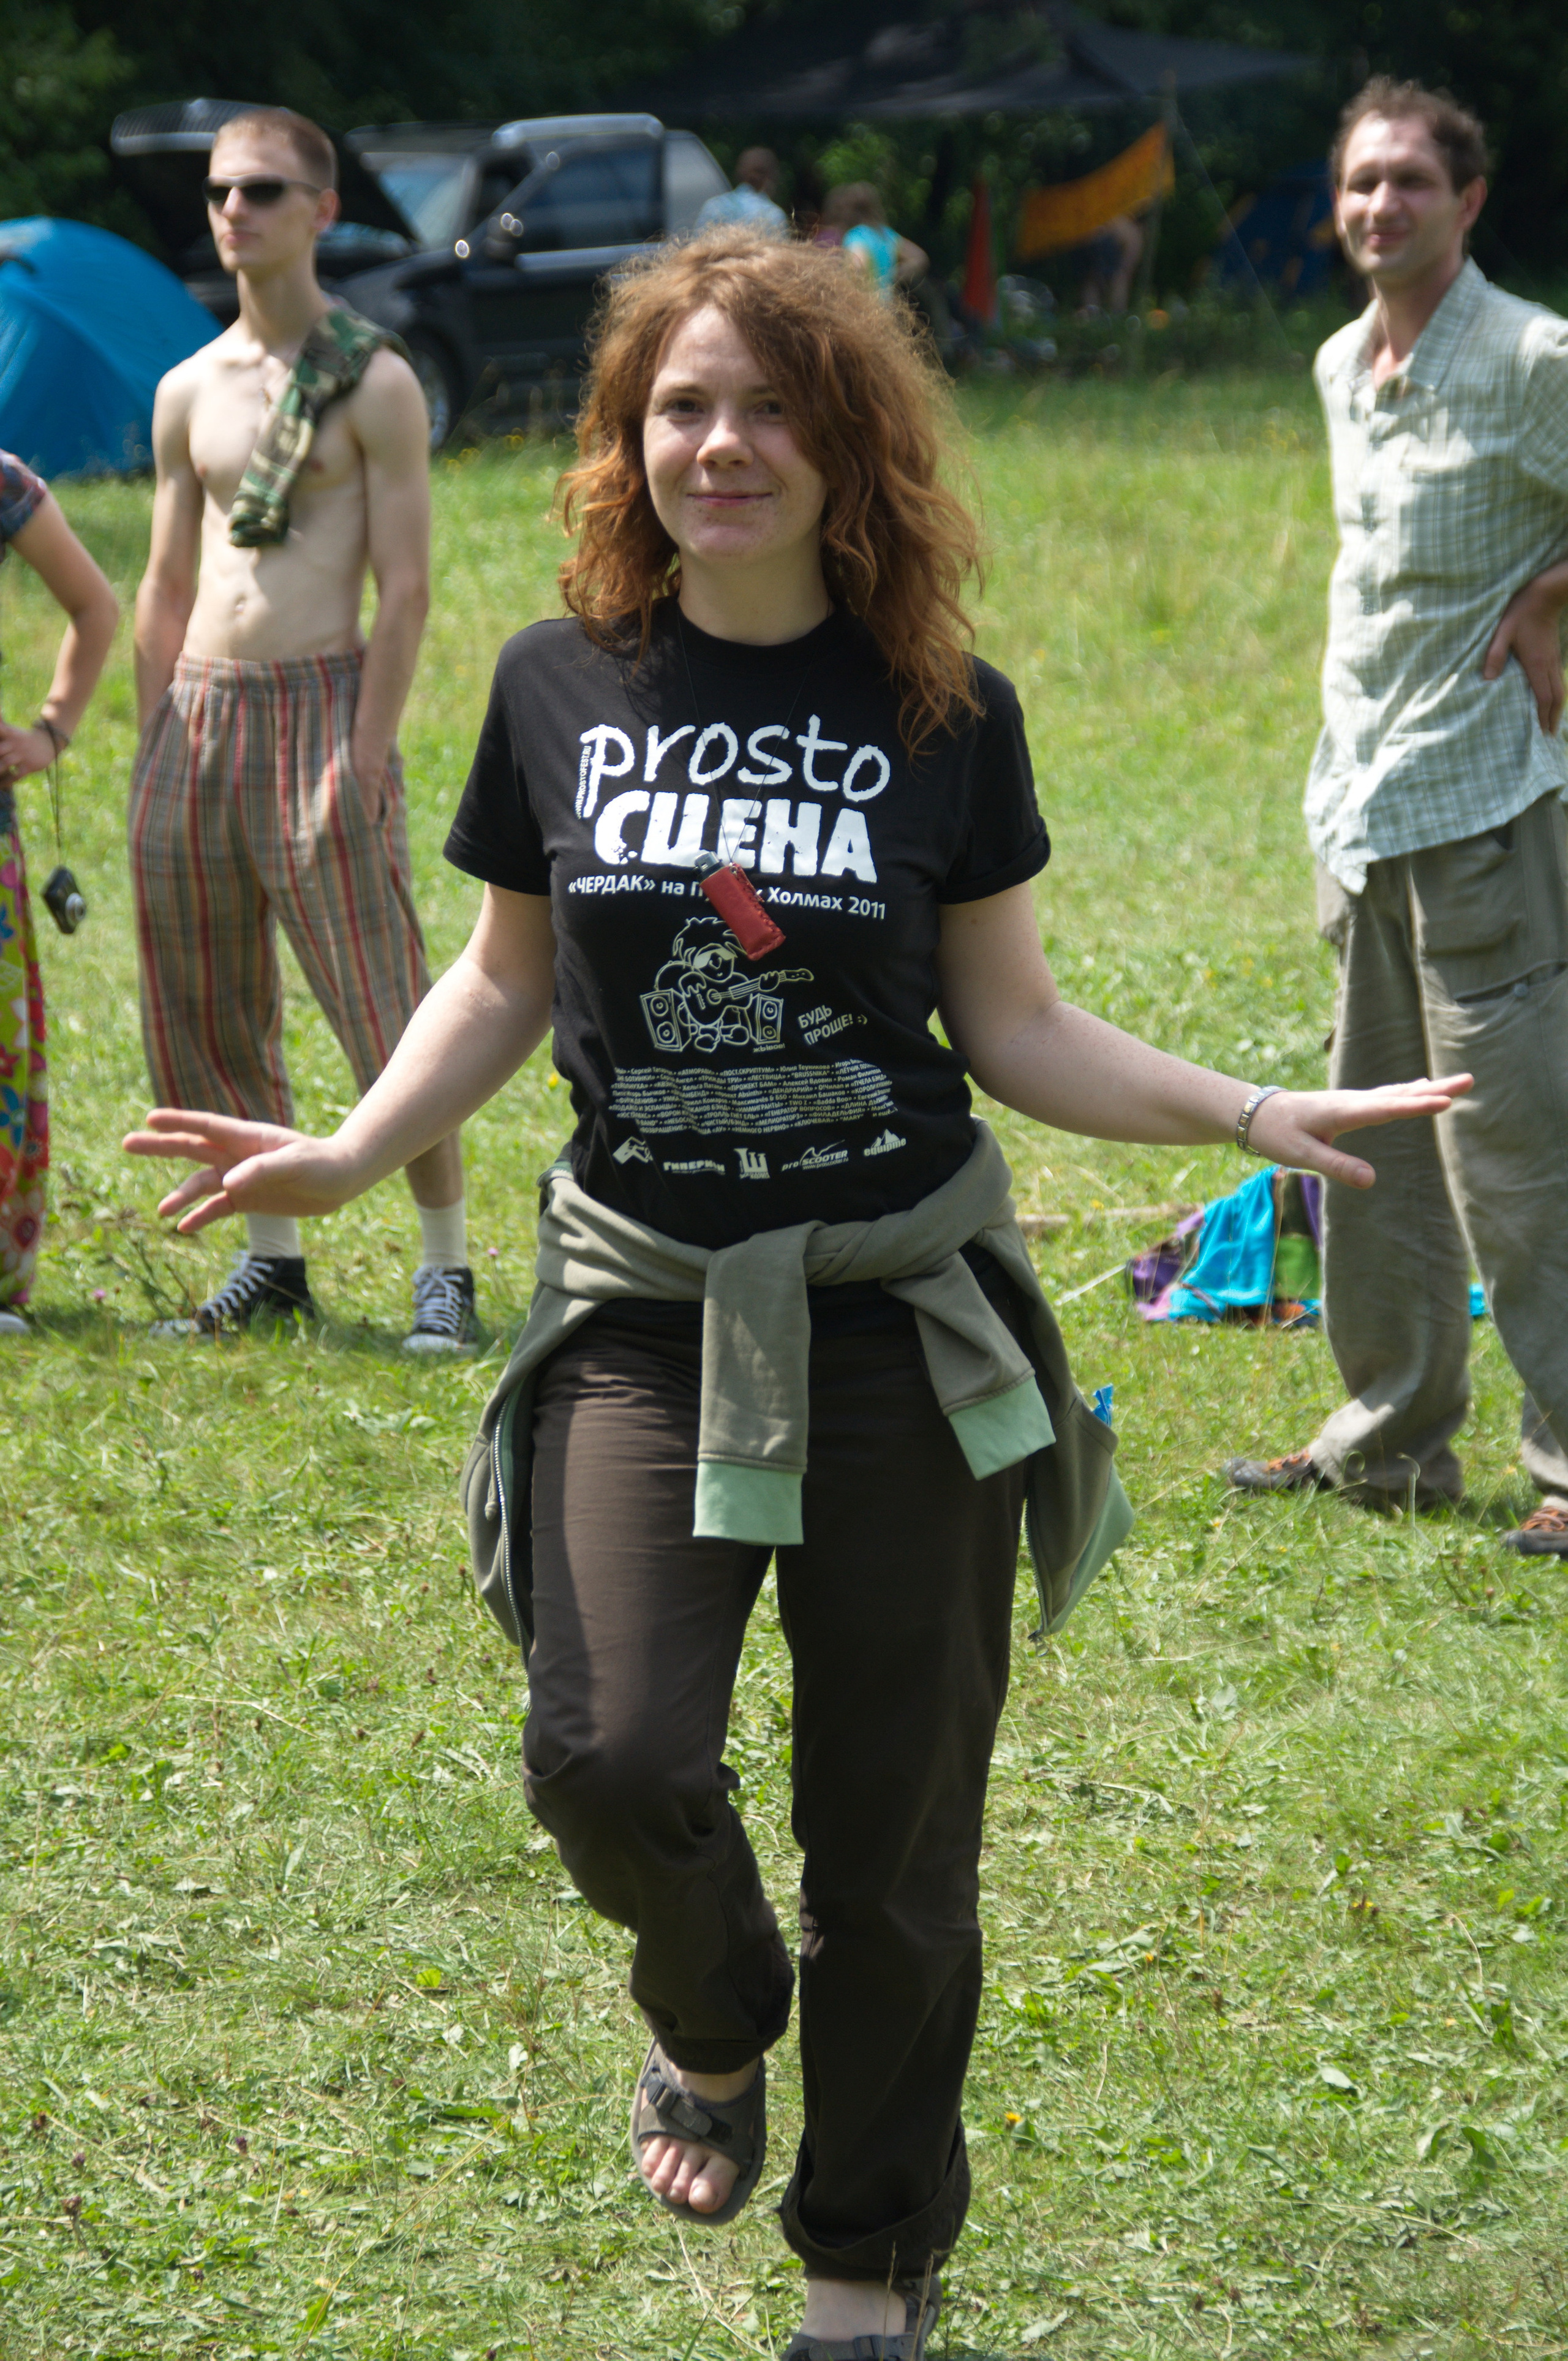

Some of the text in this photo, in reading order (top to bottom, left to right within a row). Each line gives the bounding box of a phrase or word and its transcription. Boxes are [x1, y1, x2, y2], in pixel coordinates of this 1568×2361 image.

[579, 714, 891, 818] prosto
[594, 790, 877, 883] СЦЕНА
[568, 875, 655, 895] «ЧЕРДАК»
[662, 880, 684, 895] на
[766, 887, 843, 911] Холмах
[848, 896, 885, 919] 2011
[798, 1005, 832, 1029] БУДЬ
[804, 1013, 854, 1045] ПРОЩЕ!
